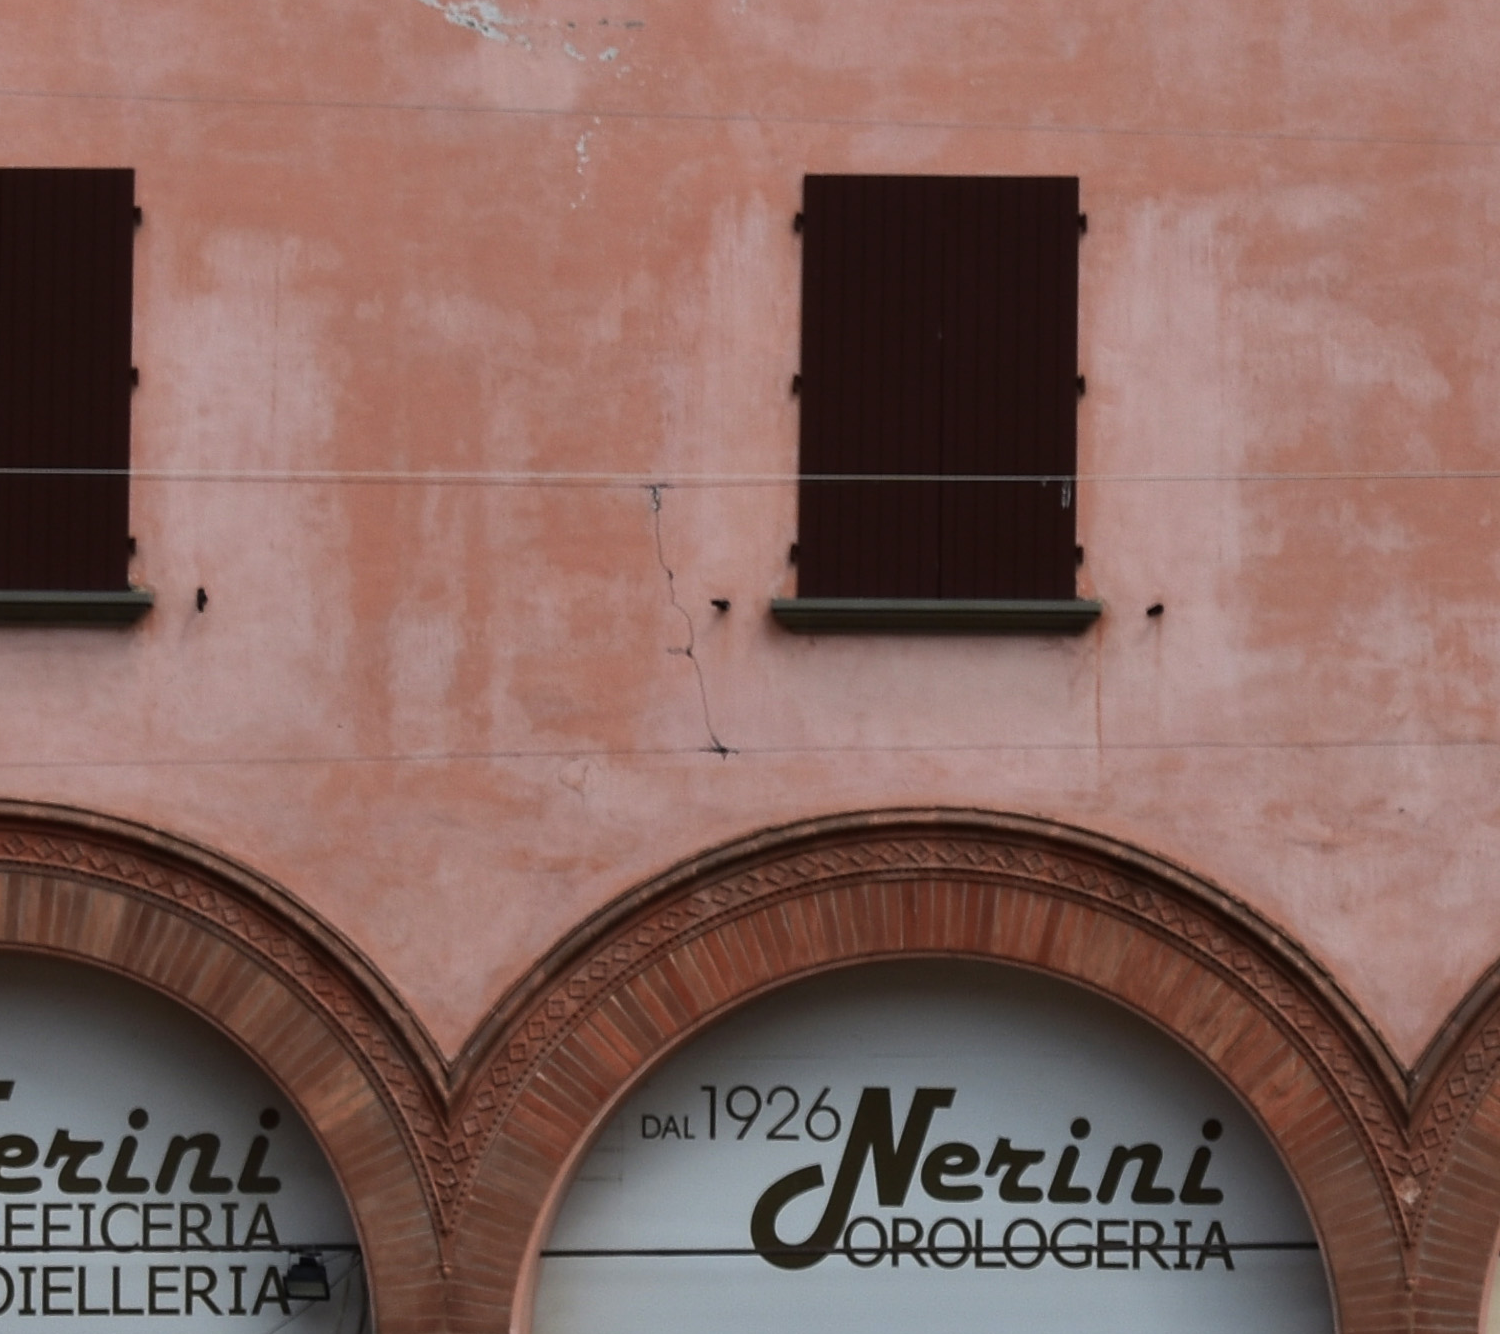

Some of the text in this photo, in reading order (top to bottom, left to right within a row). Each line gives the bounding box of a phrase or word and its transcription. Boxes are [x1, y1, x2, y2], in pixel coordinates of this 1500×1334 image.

[641, 1085, 841, 1142] DAL 1926
[751, 1086, 1224, 1271] Nerini
[842, 1217, 1234, 1271] OROLOGERIA
